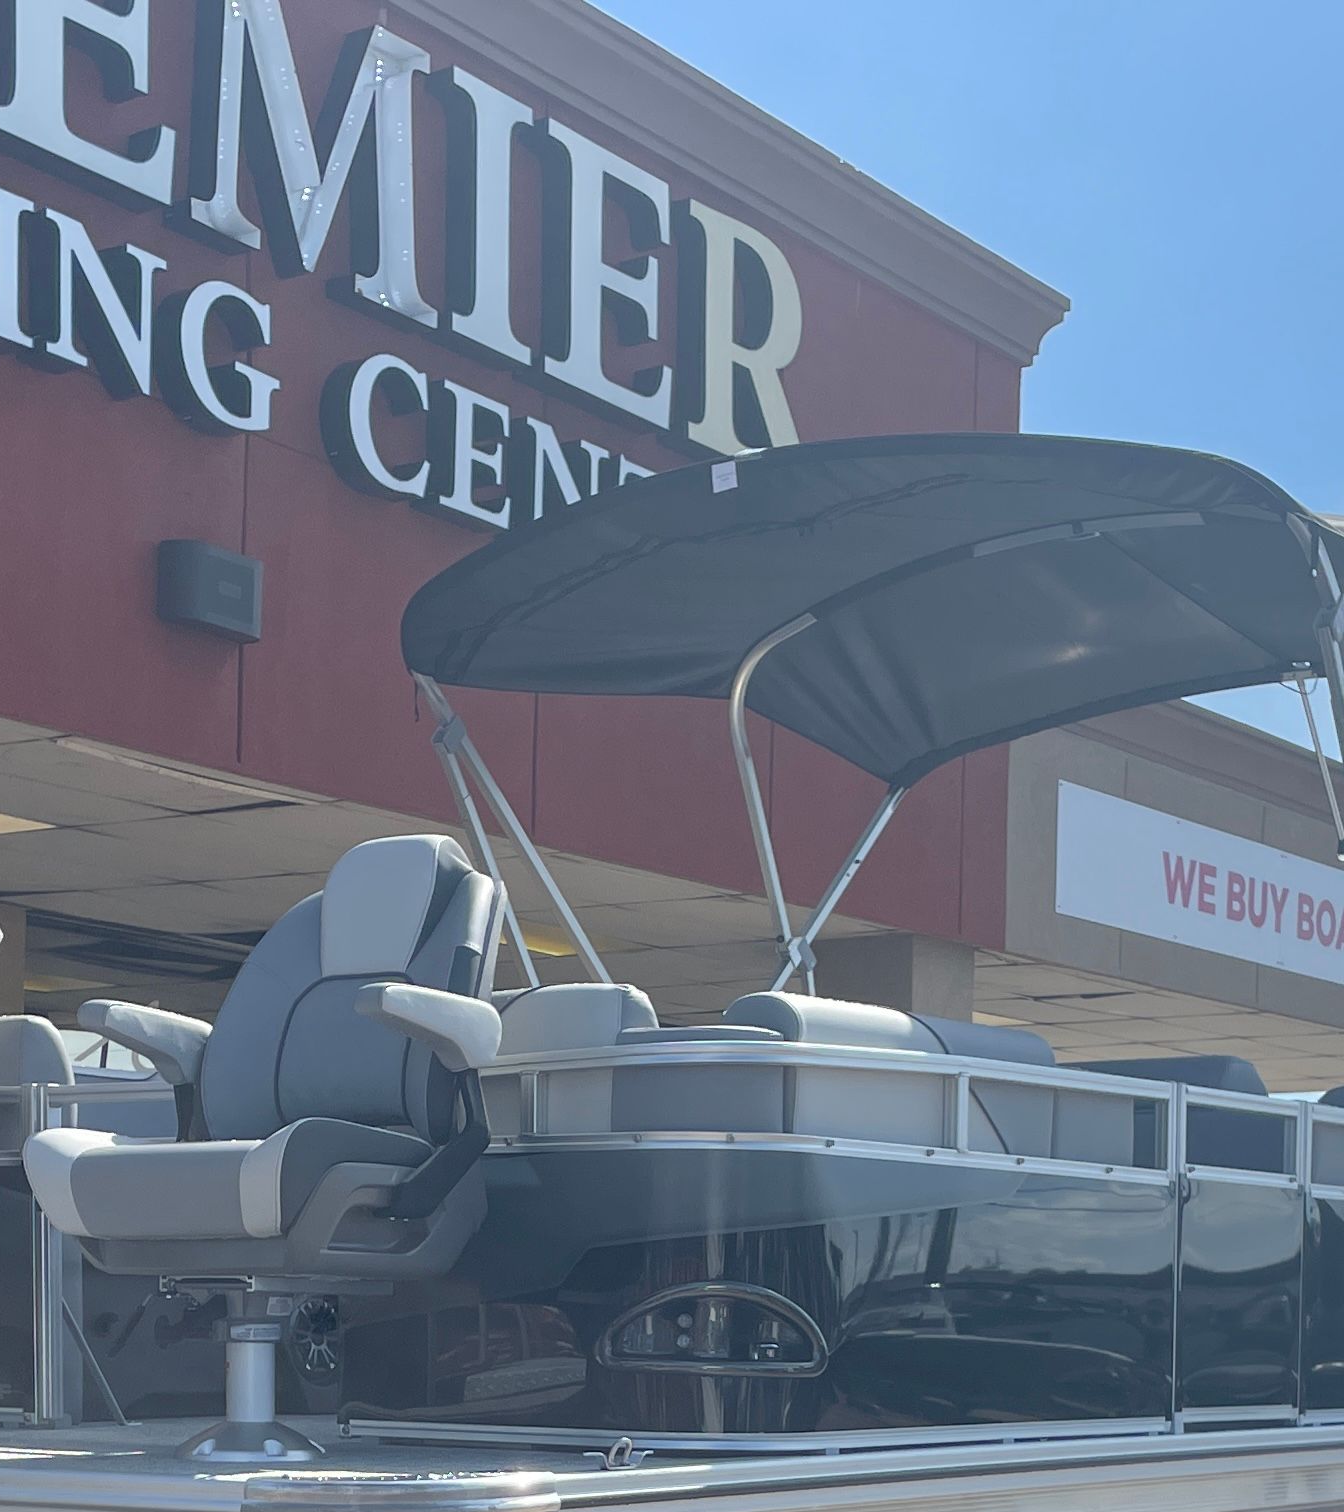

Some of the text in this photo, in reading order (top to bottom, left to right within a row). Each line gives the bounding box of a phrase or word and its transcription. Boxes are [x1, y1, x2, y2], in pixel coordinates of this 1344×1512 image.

[348, 353, 657, 529] CEN
[1162, 850, 1218, 916] WE
[1226, 870, 1290, 934] BUY
